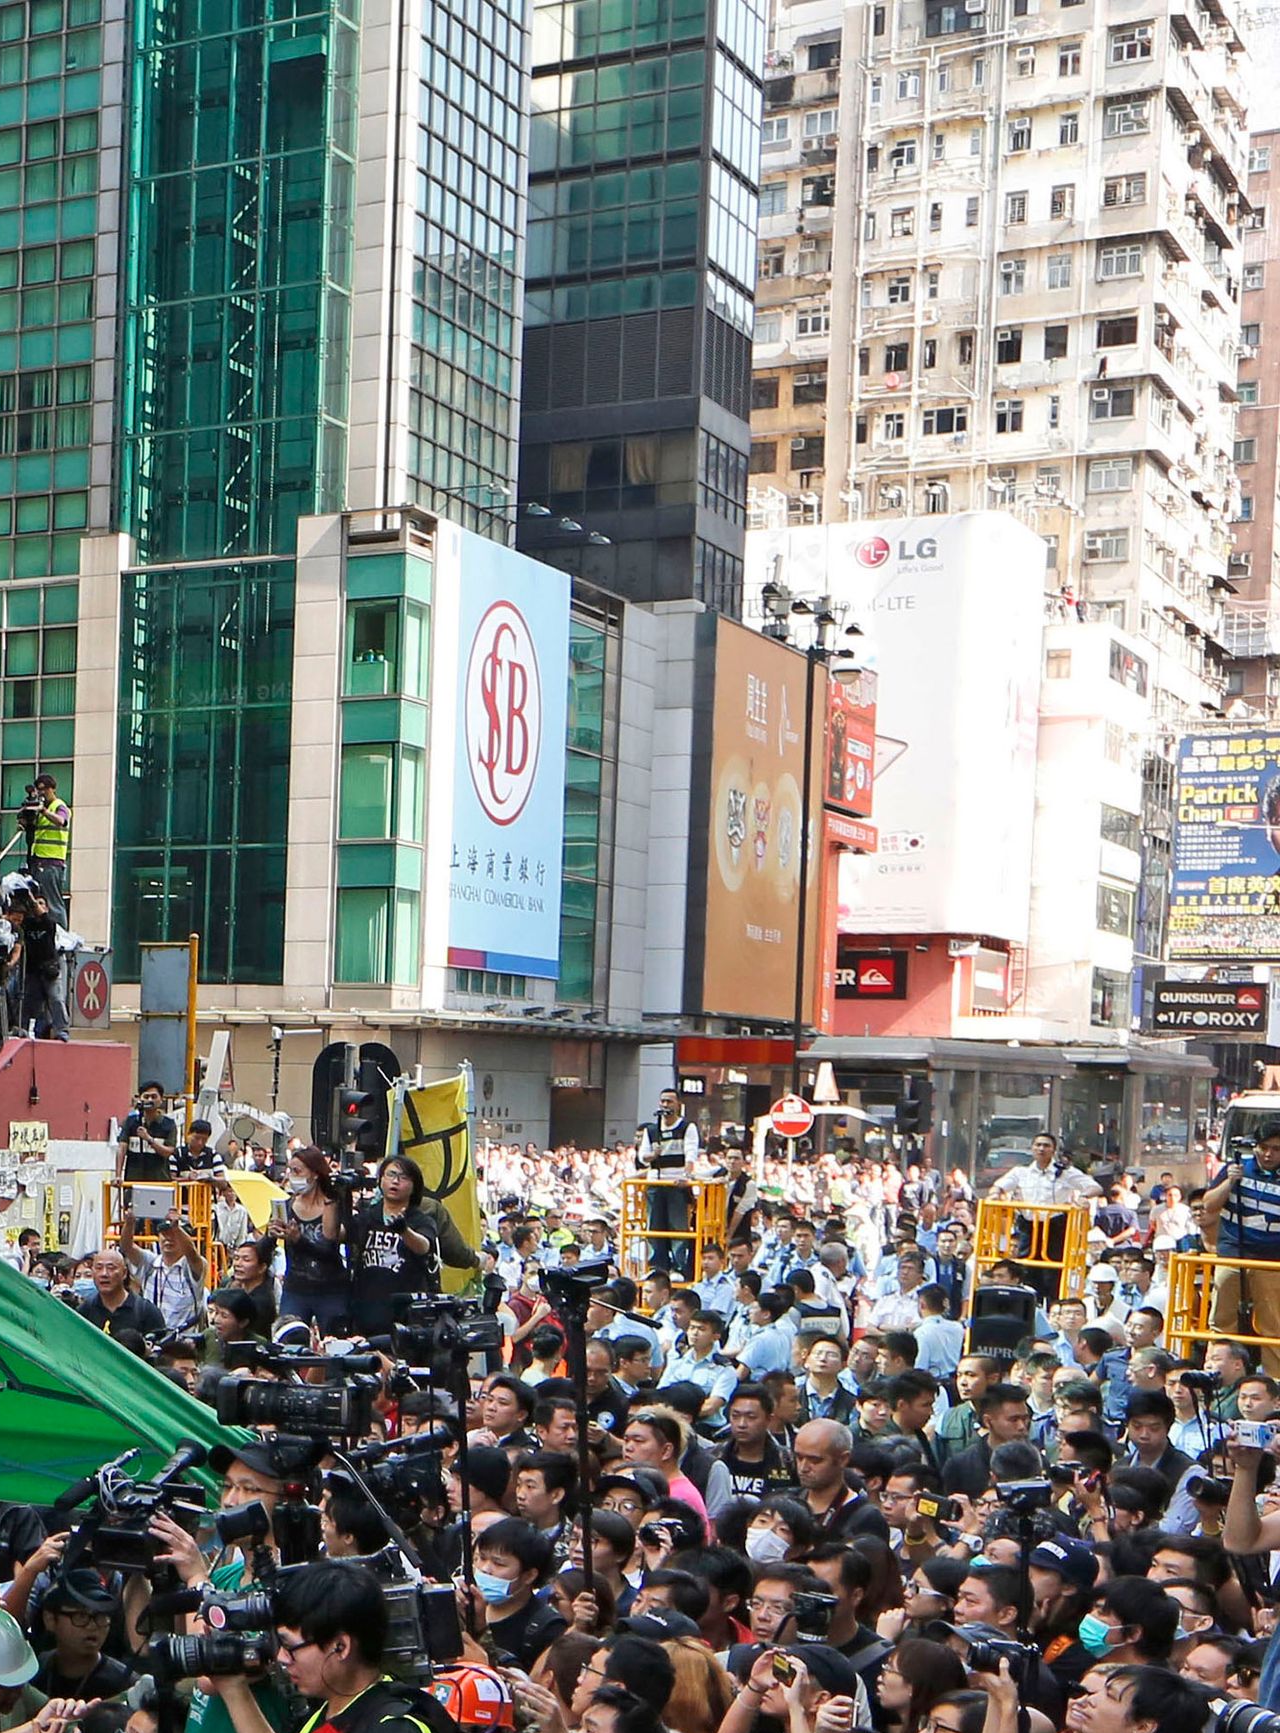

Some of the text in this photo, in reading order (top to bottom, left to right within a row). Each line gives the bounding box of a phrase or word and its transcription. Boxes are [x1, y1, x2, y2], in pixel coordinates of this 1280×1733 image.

[898, 538, 938, 560] LG
[1179, 783, 1259, 805] Patrick
[1178, 804, 1224, 822] Chan
[449, 843, 546, 887] 上海商業銀行
[1159, 991, 1236, 1005] QUIKSILVER
[1208, 1012, 1260, 1026] ROXY
